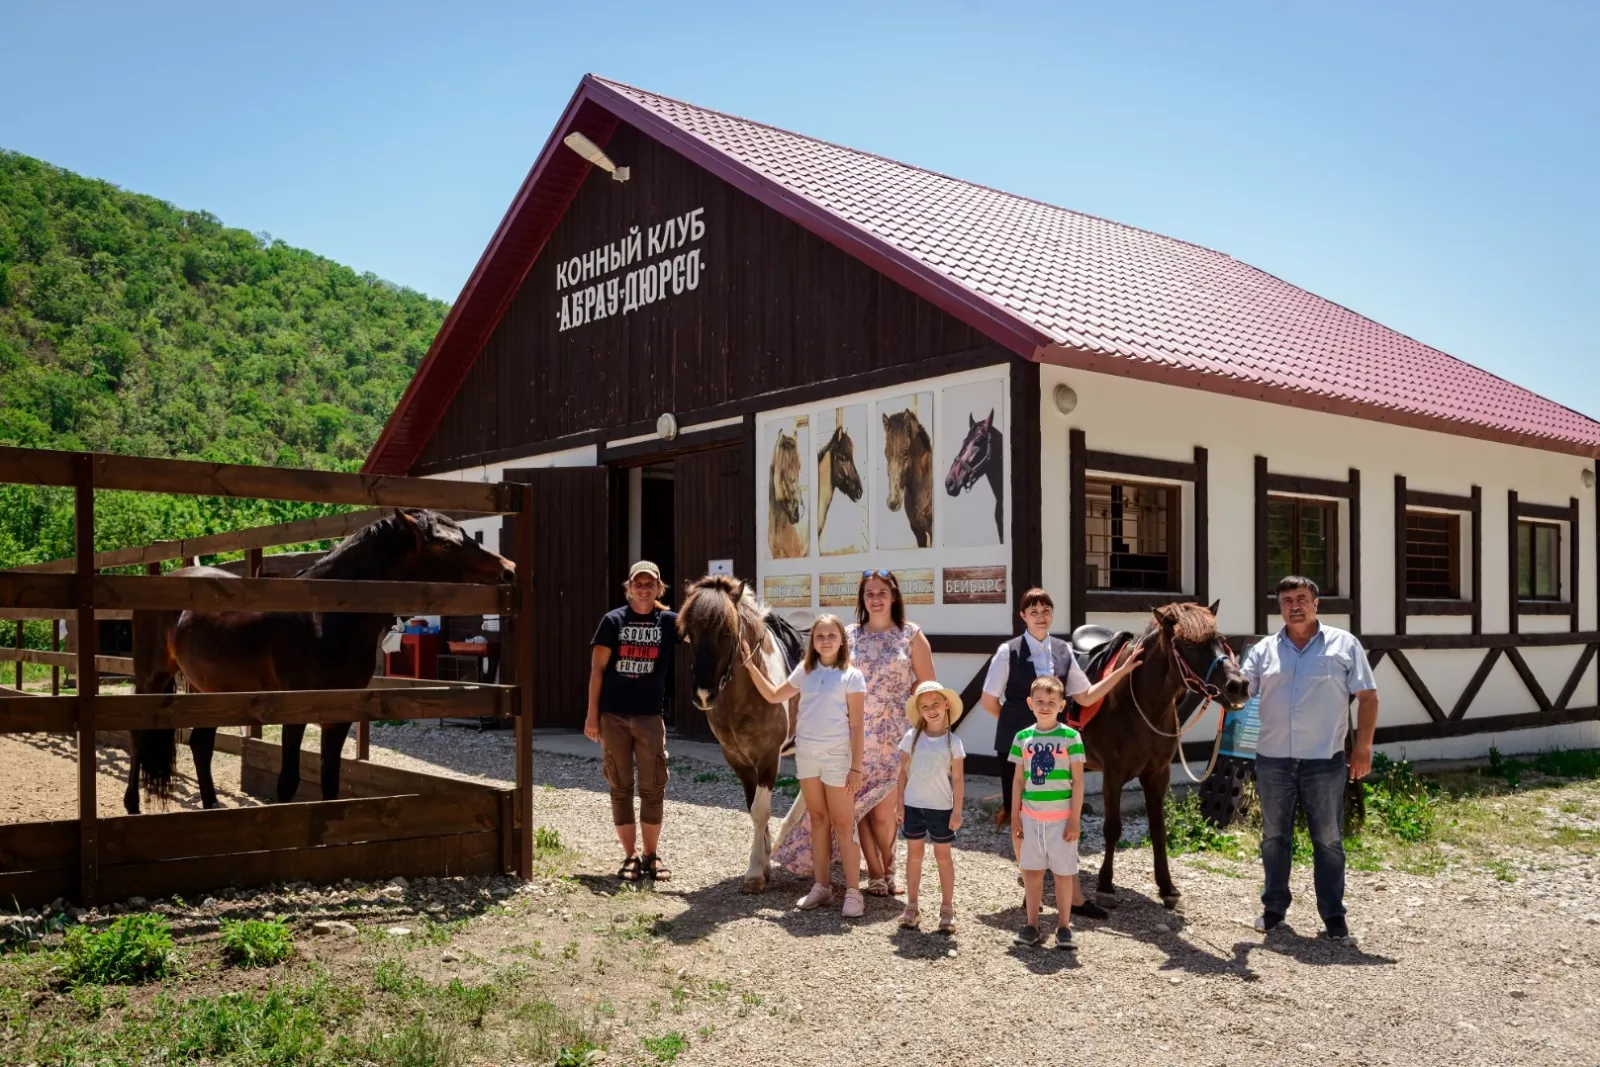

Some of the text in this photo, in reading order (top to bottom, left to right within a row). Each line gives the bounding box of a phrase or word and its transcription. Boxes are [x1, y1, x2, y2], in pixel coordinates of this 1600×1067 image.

[556, 207, 705, 291] КОННЫЙ КЛУБ
[945, 576, 1004, 593] БЕЙБАРС
[623, 628, 659, 640] SOUND
[1027, 742, 1063, 754] COOL
